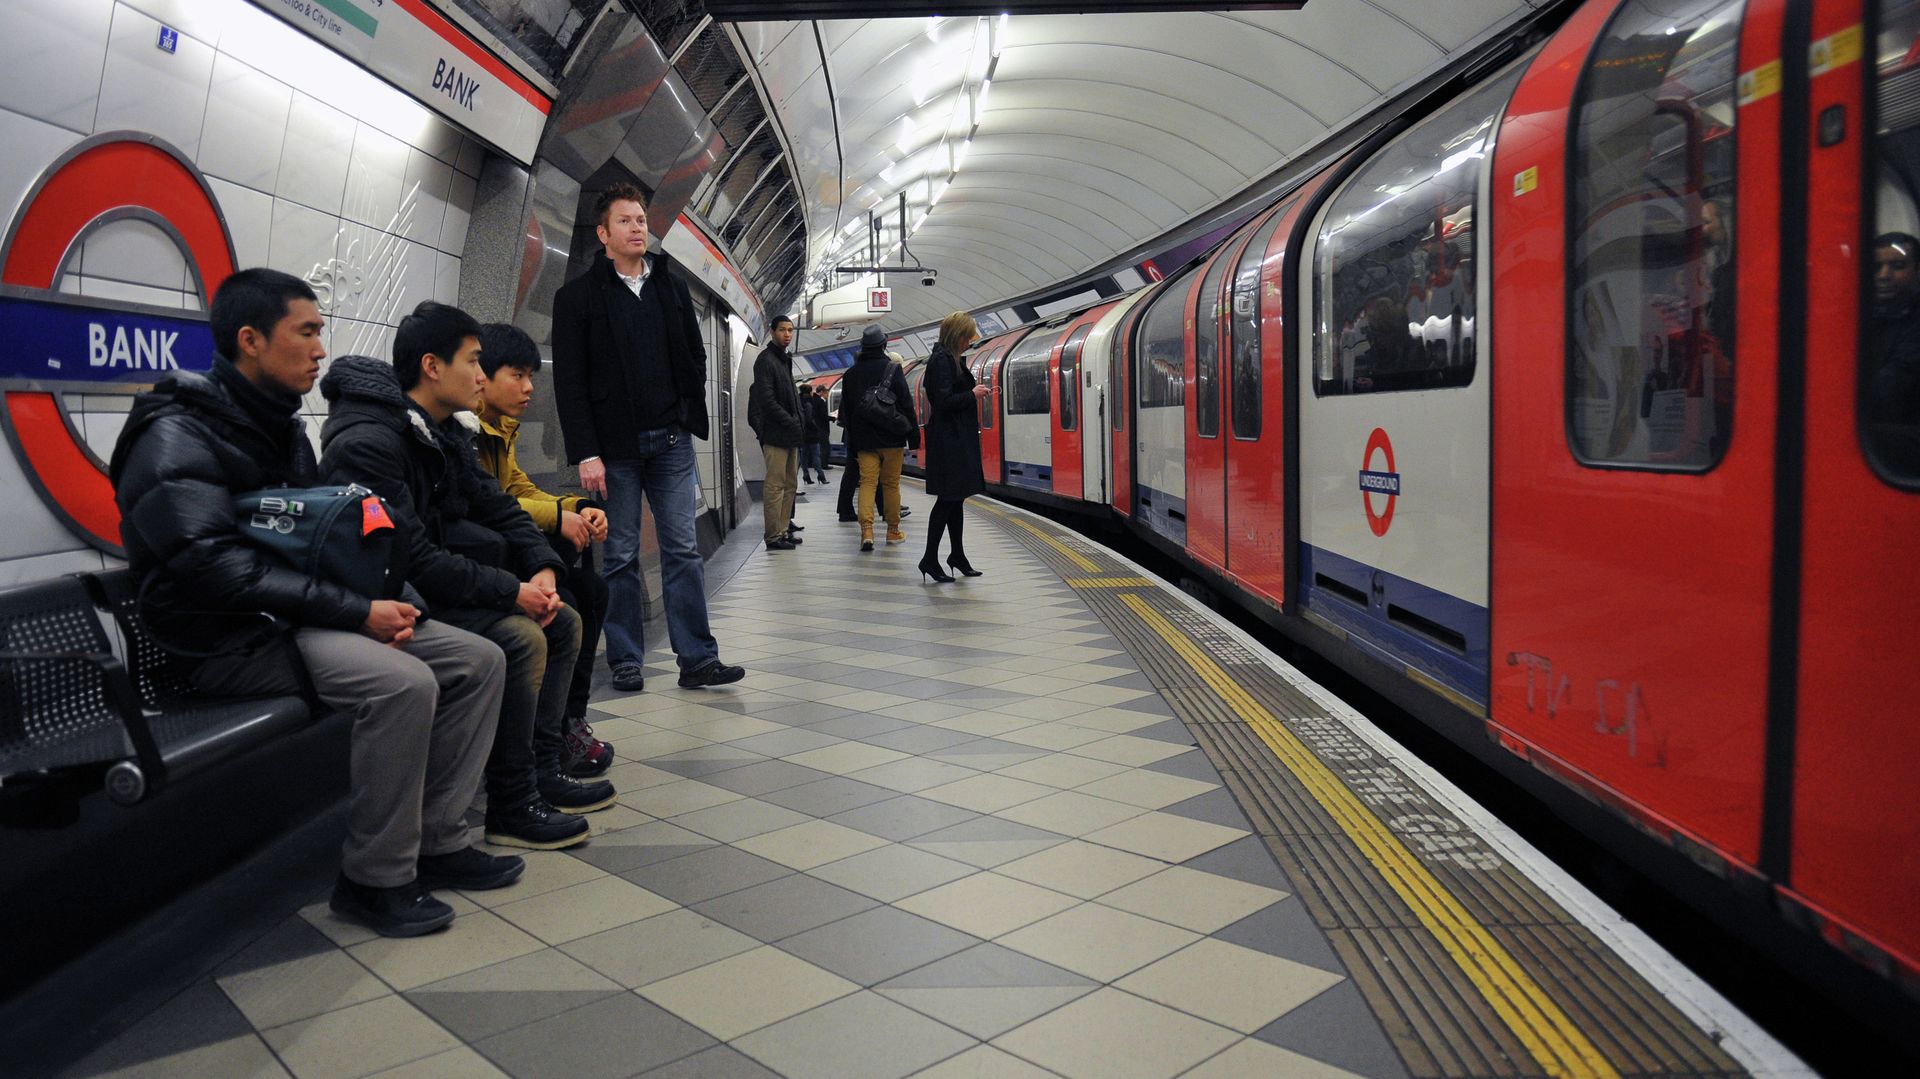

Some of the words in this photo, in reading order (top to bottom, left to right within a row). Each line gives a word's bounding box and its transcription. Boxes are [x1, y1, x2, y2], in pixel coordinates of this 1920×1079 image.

[304, 4, 311, 16] &
[312, 9, 328, 29] City
[328, 18, 342, 35] line
[432, 58, 480, 111] BANK
[89, 323, 179, 370] BANK
[1361, 475, 1397, 490] UNDERGROUND
[1343, 767, 1428, 806] THE
[1389, 814, 1502, 870] GAP
